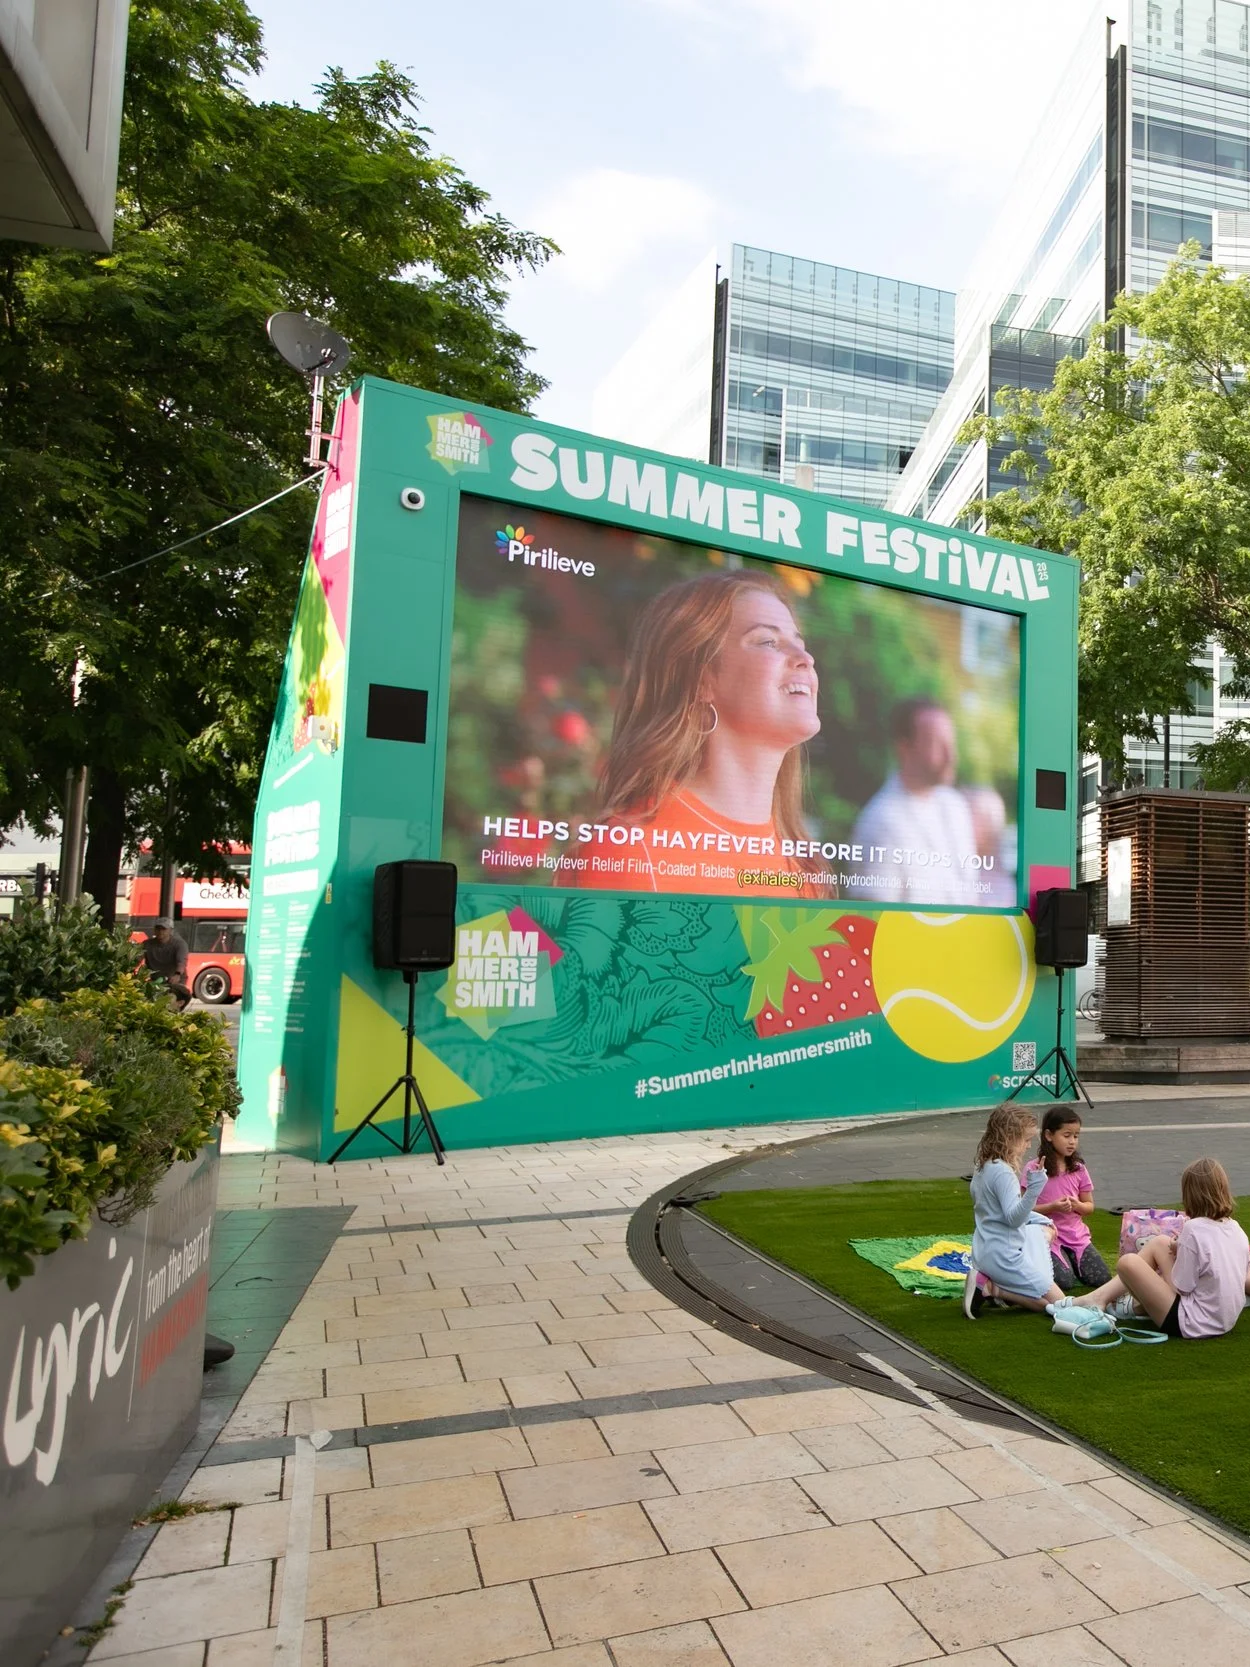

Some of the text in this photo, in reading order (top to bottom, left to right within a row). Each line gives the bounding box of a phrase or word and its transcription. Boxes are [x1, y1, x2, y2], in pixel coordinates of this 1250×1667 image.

[436, 429, 470, 449] MER
[437, 416, 481, 439] HAM
[435, 443, 480, 465] SMITH
[509, 432, 802, 549] SUMMER
[508, 539, 597, 577] Pirilieve
[1036, 561, 1048, 573] 20
[1038, 571, 1050, 582] 25
[483, 815, 995, 872] HELPS STOP HAYFEVER BEFORE IT STOPS YOU
[481, 849, 534, 868] Pirilieve
[536, 853, 589, 873] Hayfever
[592, 856, 626, 873] Relief
[627, 859, 697, 877] Film-Coated
[699, 862, 736, 879] Tablets
[200, 885, 234, 900] Check
[738, 869, 804, 890] (exhales)
[458, 929, 540, 957] HAM
[457, 957, 520, 981] MER
[454, 980, 538, 1009] SMITH
[634, 1028, 873, 1099] #SummerInHammersmith
[145, 1266, 168, 1322] from
[168, 1248, 182, 1299] the
[182, 1227, 204, 1284] heart
